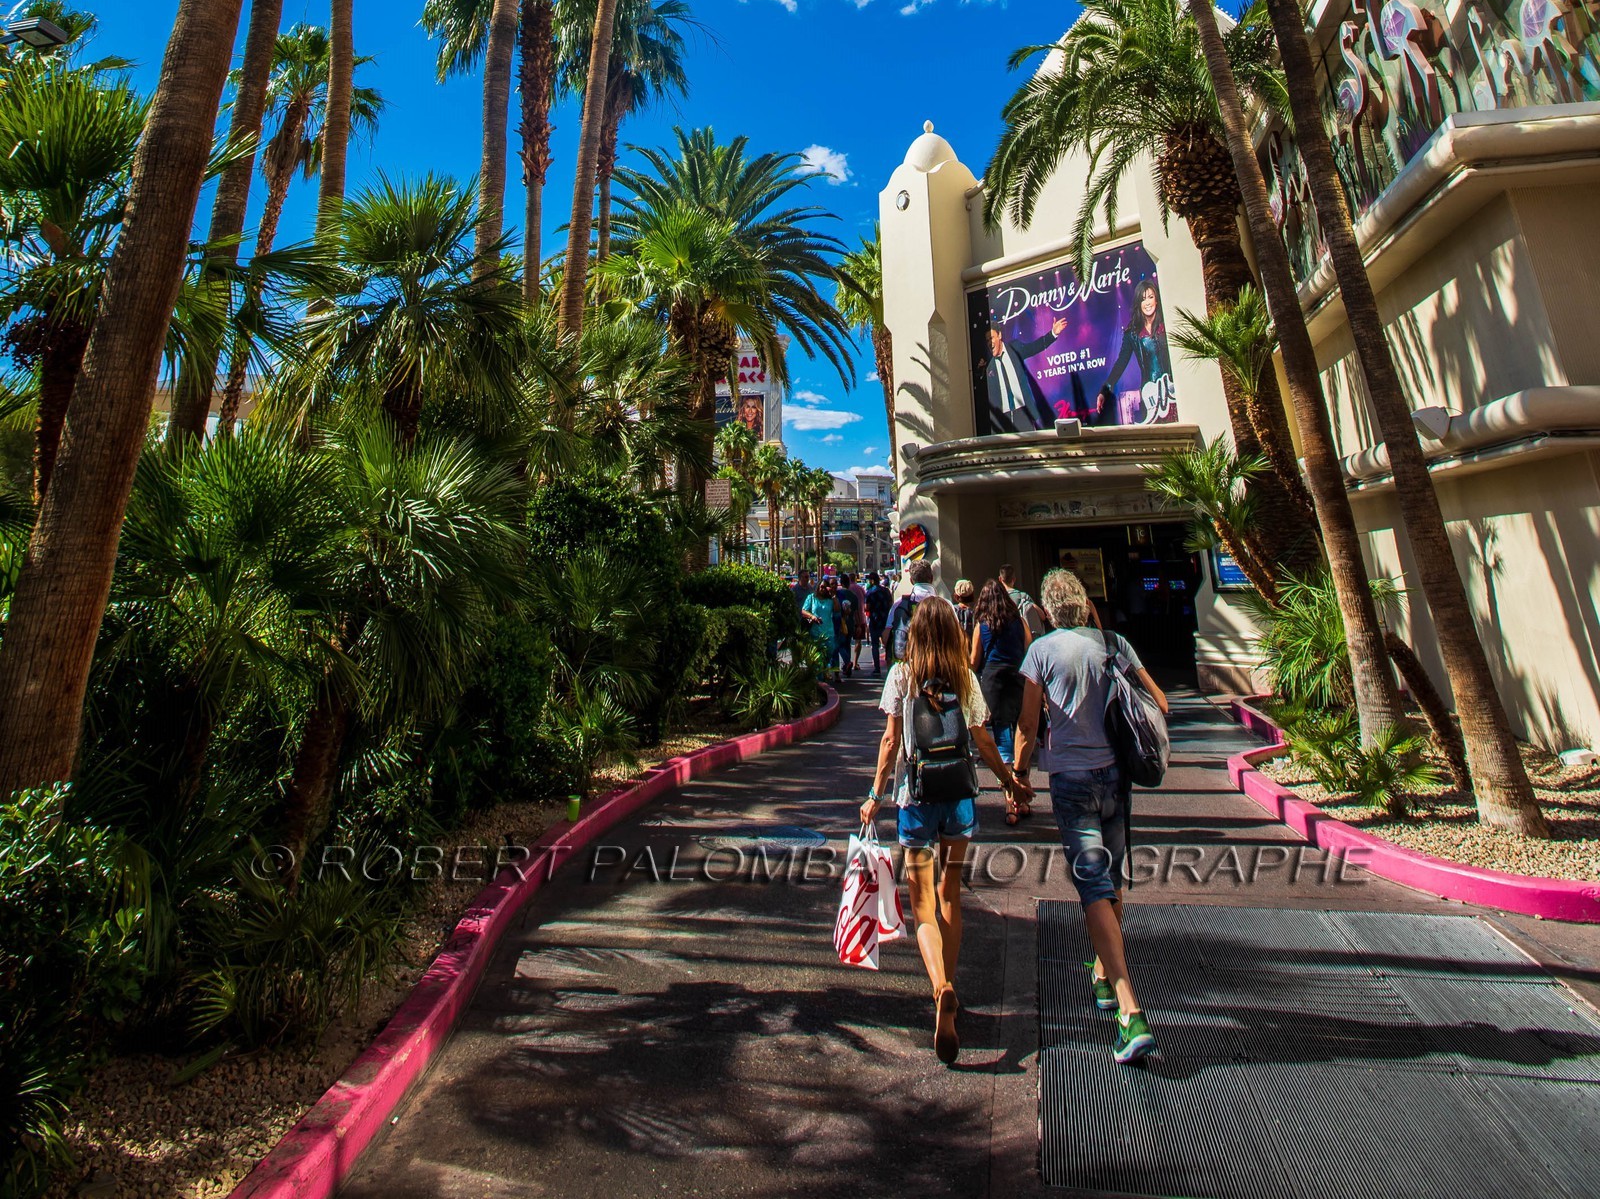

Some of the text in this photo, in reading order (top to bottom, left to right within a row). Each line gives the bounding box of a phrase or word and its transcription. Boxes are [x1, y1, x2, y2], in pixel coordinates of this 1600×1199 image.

[996, 257, 1130, 325] Donny & Marie
[1036, 370, 1042, 380] 3
[1043, 366, 1066, 378] YEARS
[1086, 357, 1106, 369] ROW
[1047, 348, 1090, 366] VOTED #1
